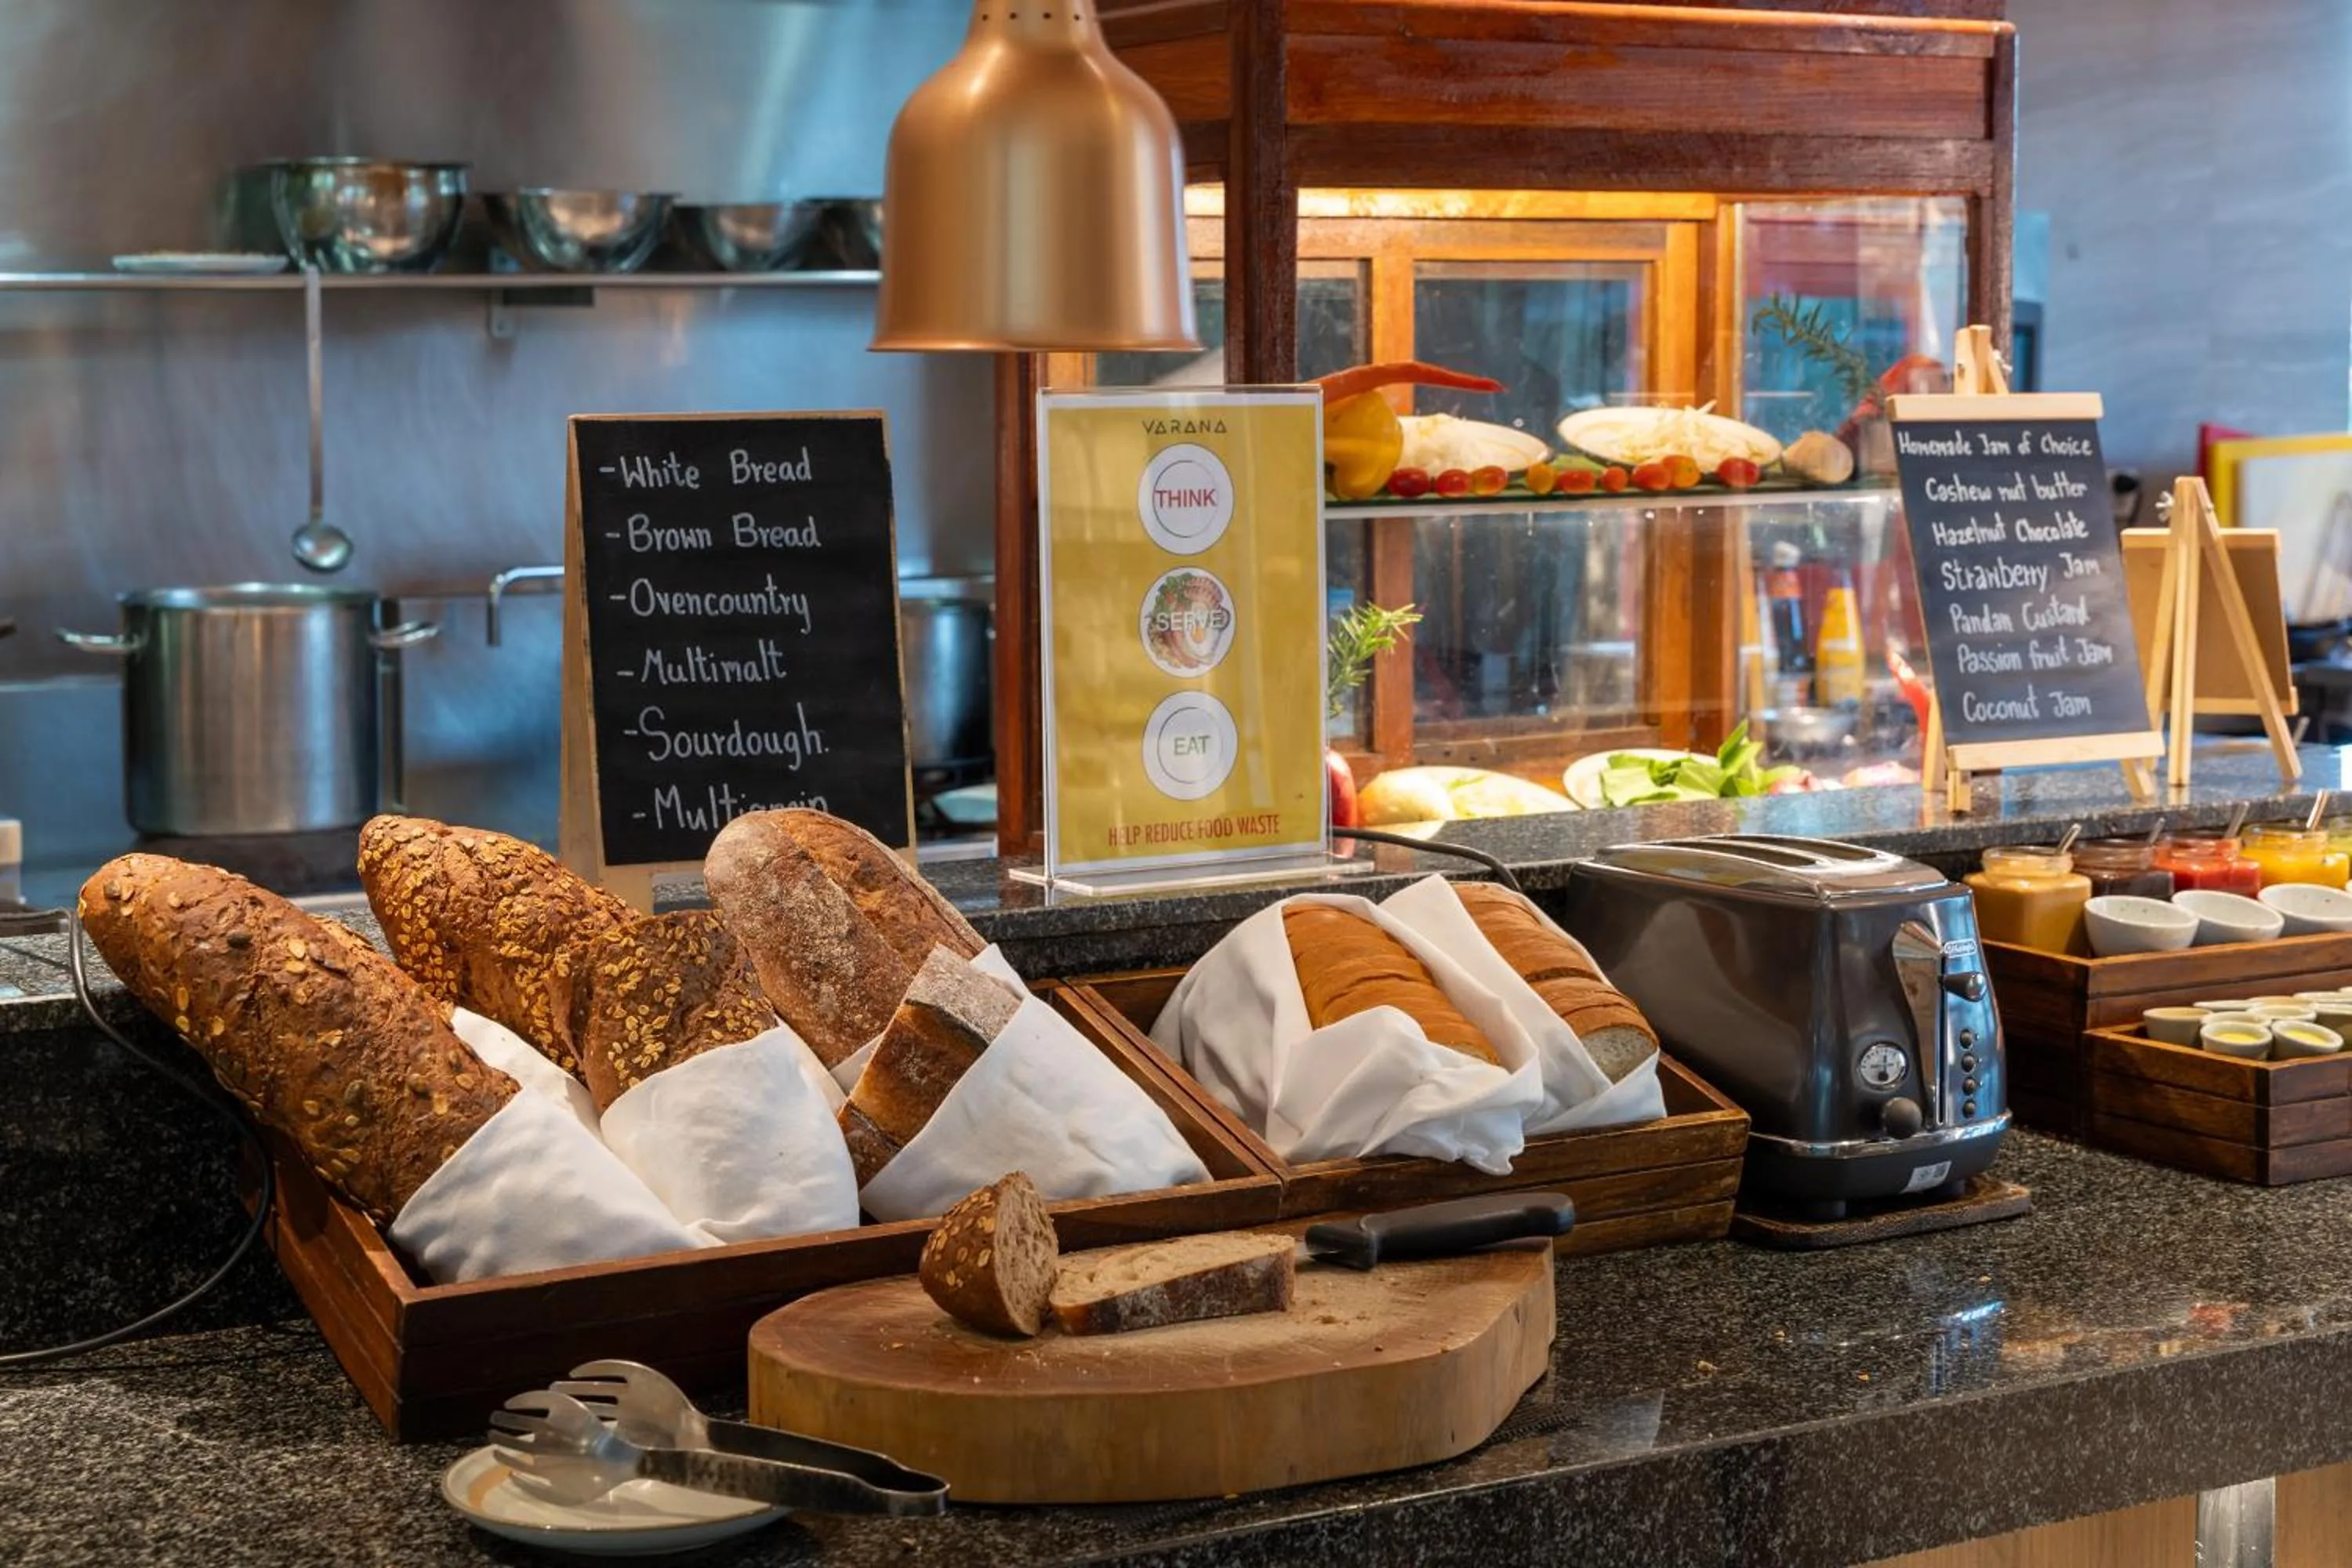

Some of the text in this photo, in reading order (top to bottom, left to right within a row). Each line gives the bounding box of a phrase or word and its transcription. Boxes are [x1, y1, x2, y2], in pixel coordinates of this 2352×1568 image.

[1142, 419, 1228, 435] VARANA
[1898, 430, 2092, 456] Homemade Jam of Choice
[729, 446, 812, 485] Bread
[1154, 488, 1217, 508] THINK
[1925, 471, 2088, 503] Cashew nut butter
[731, 512, 822, 548] Bread
[1931, 510, 2090, 546] Hazelnut Chocolate
[1940, 552, 2101, 593] Strawberry Jam
[1156, 608, 1225, 631] SERVE
[1949, 593, 2091, 634] Pandan Custard
[1957, 634, 2113, 673] Passion fruit Jam
[1962, 683, 2092, 722] Coconut Jam
[1174, 735, 1210, 756] EAT
[1145, 821, 1195, 844] REDUCE
[1198, 817, 1233, 839] FOOD
[1237, 814, 1280, 836] WASTE
